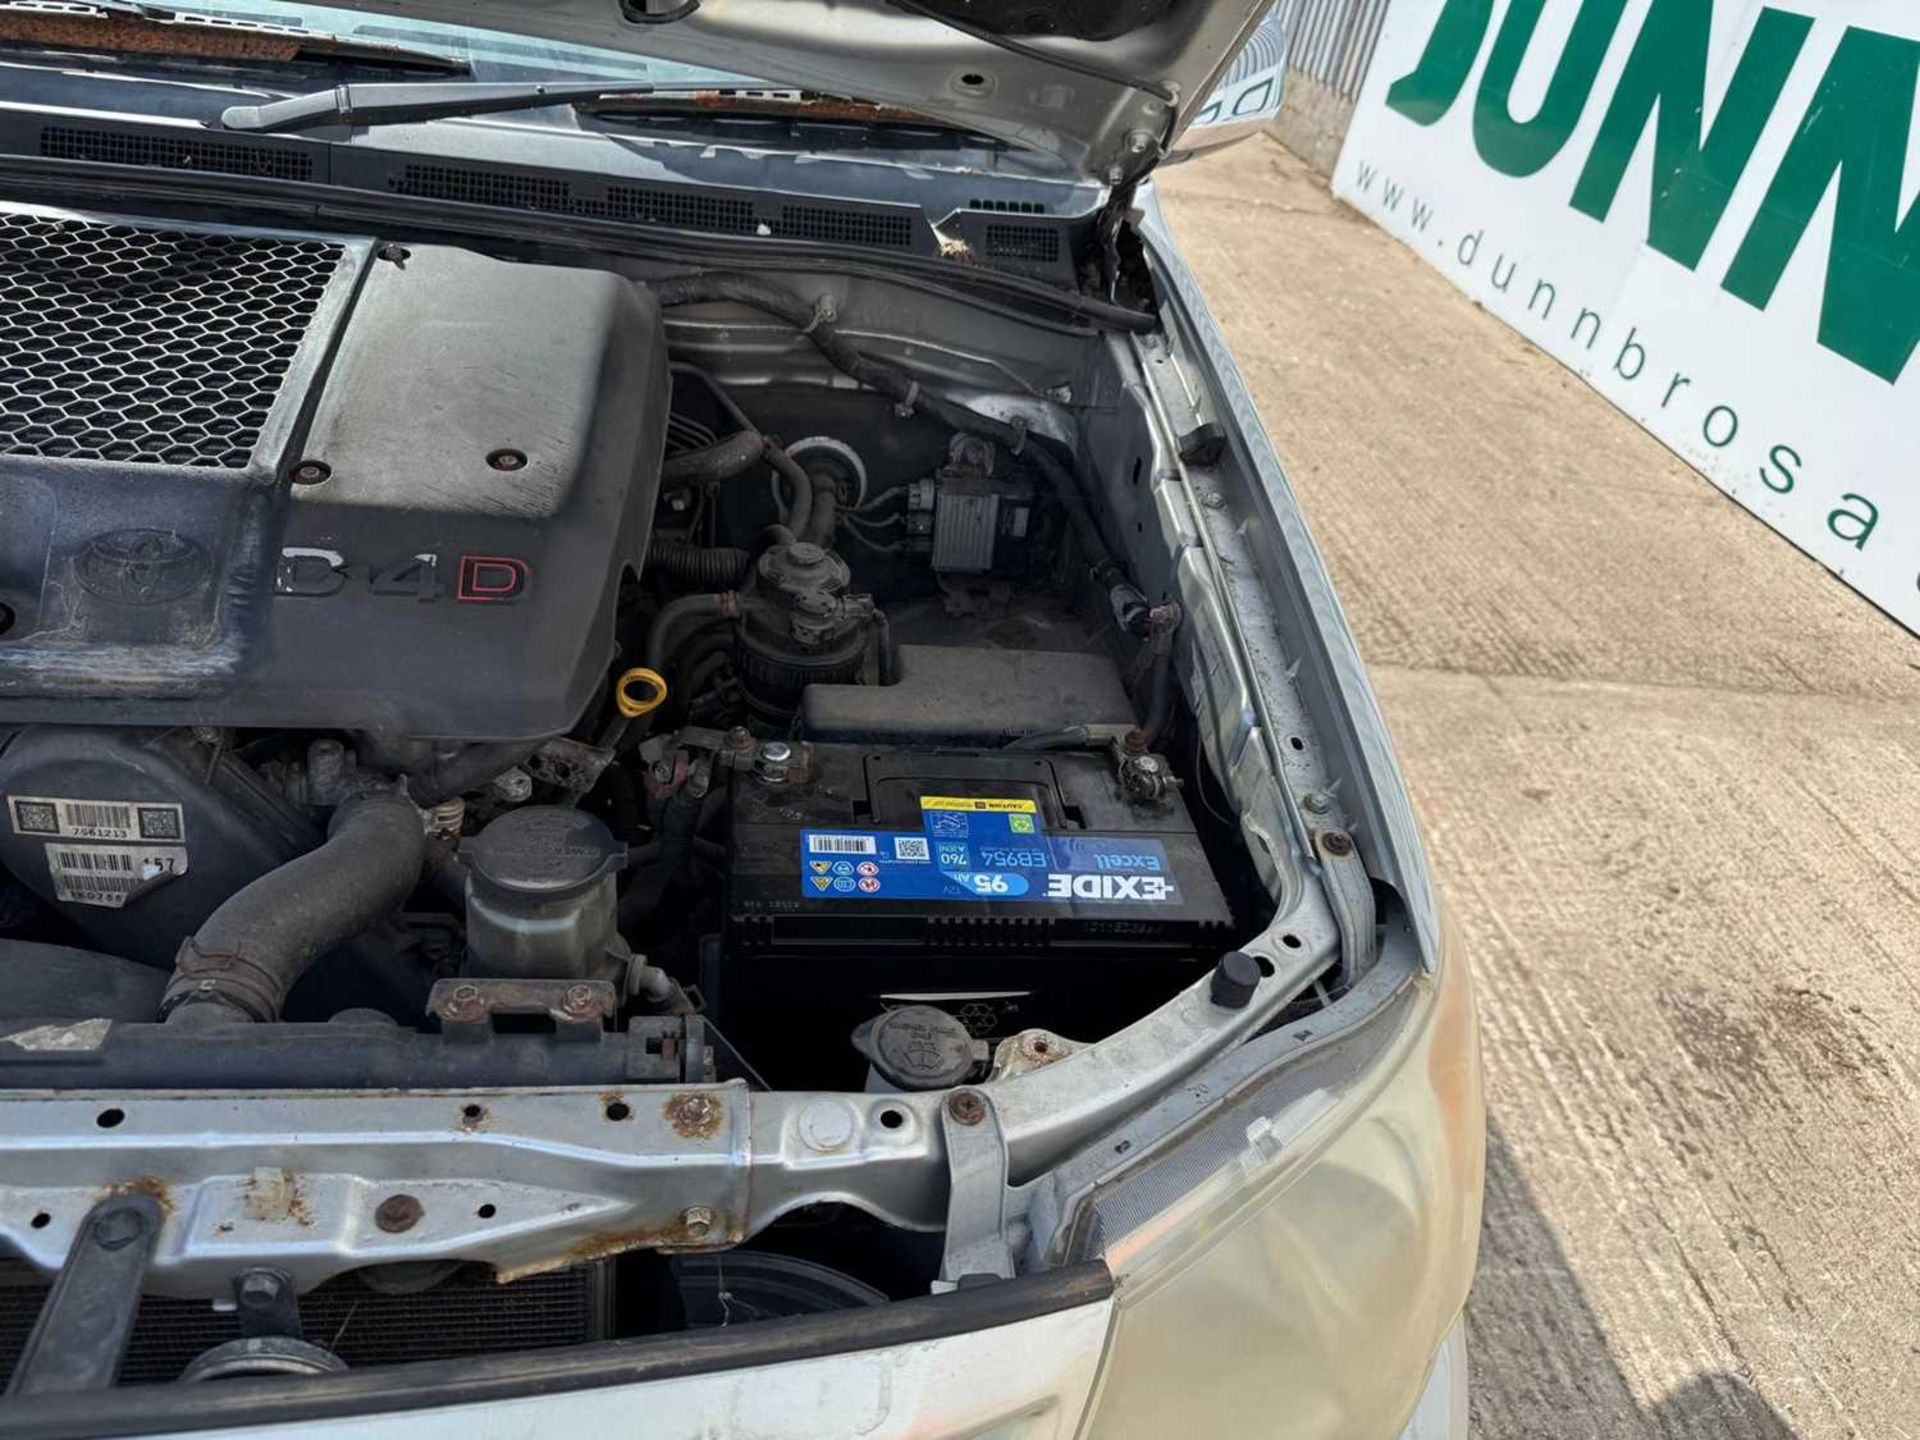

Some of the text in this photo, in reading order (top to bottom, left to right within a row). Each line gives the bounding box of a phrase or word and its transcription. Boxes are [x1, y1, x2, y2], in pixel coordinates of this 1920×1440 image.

[1355, 159, 1920, 592] www.dunnbrosa
[941, 852, 968, 865] 760
[981, 850, 1047, 867] EB954
[1094, 853, 1161, 871] Excell
[975, 874, 1009, 892] 95
[1047, 873, 1174, 899] EXIDE
